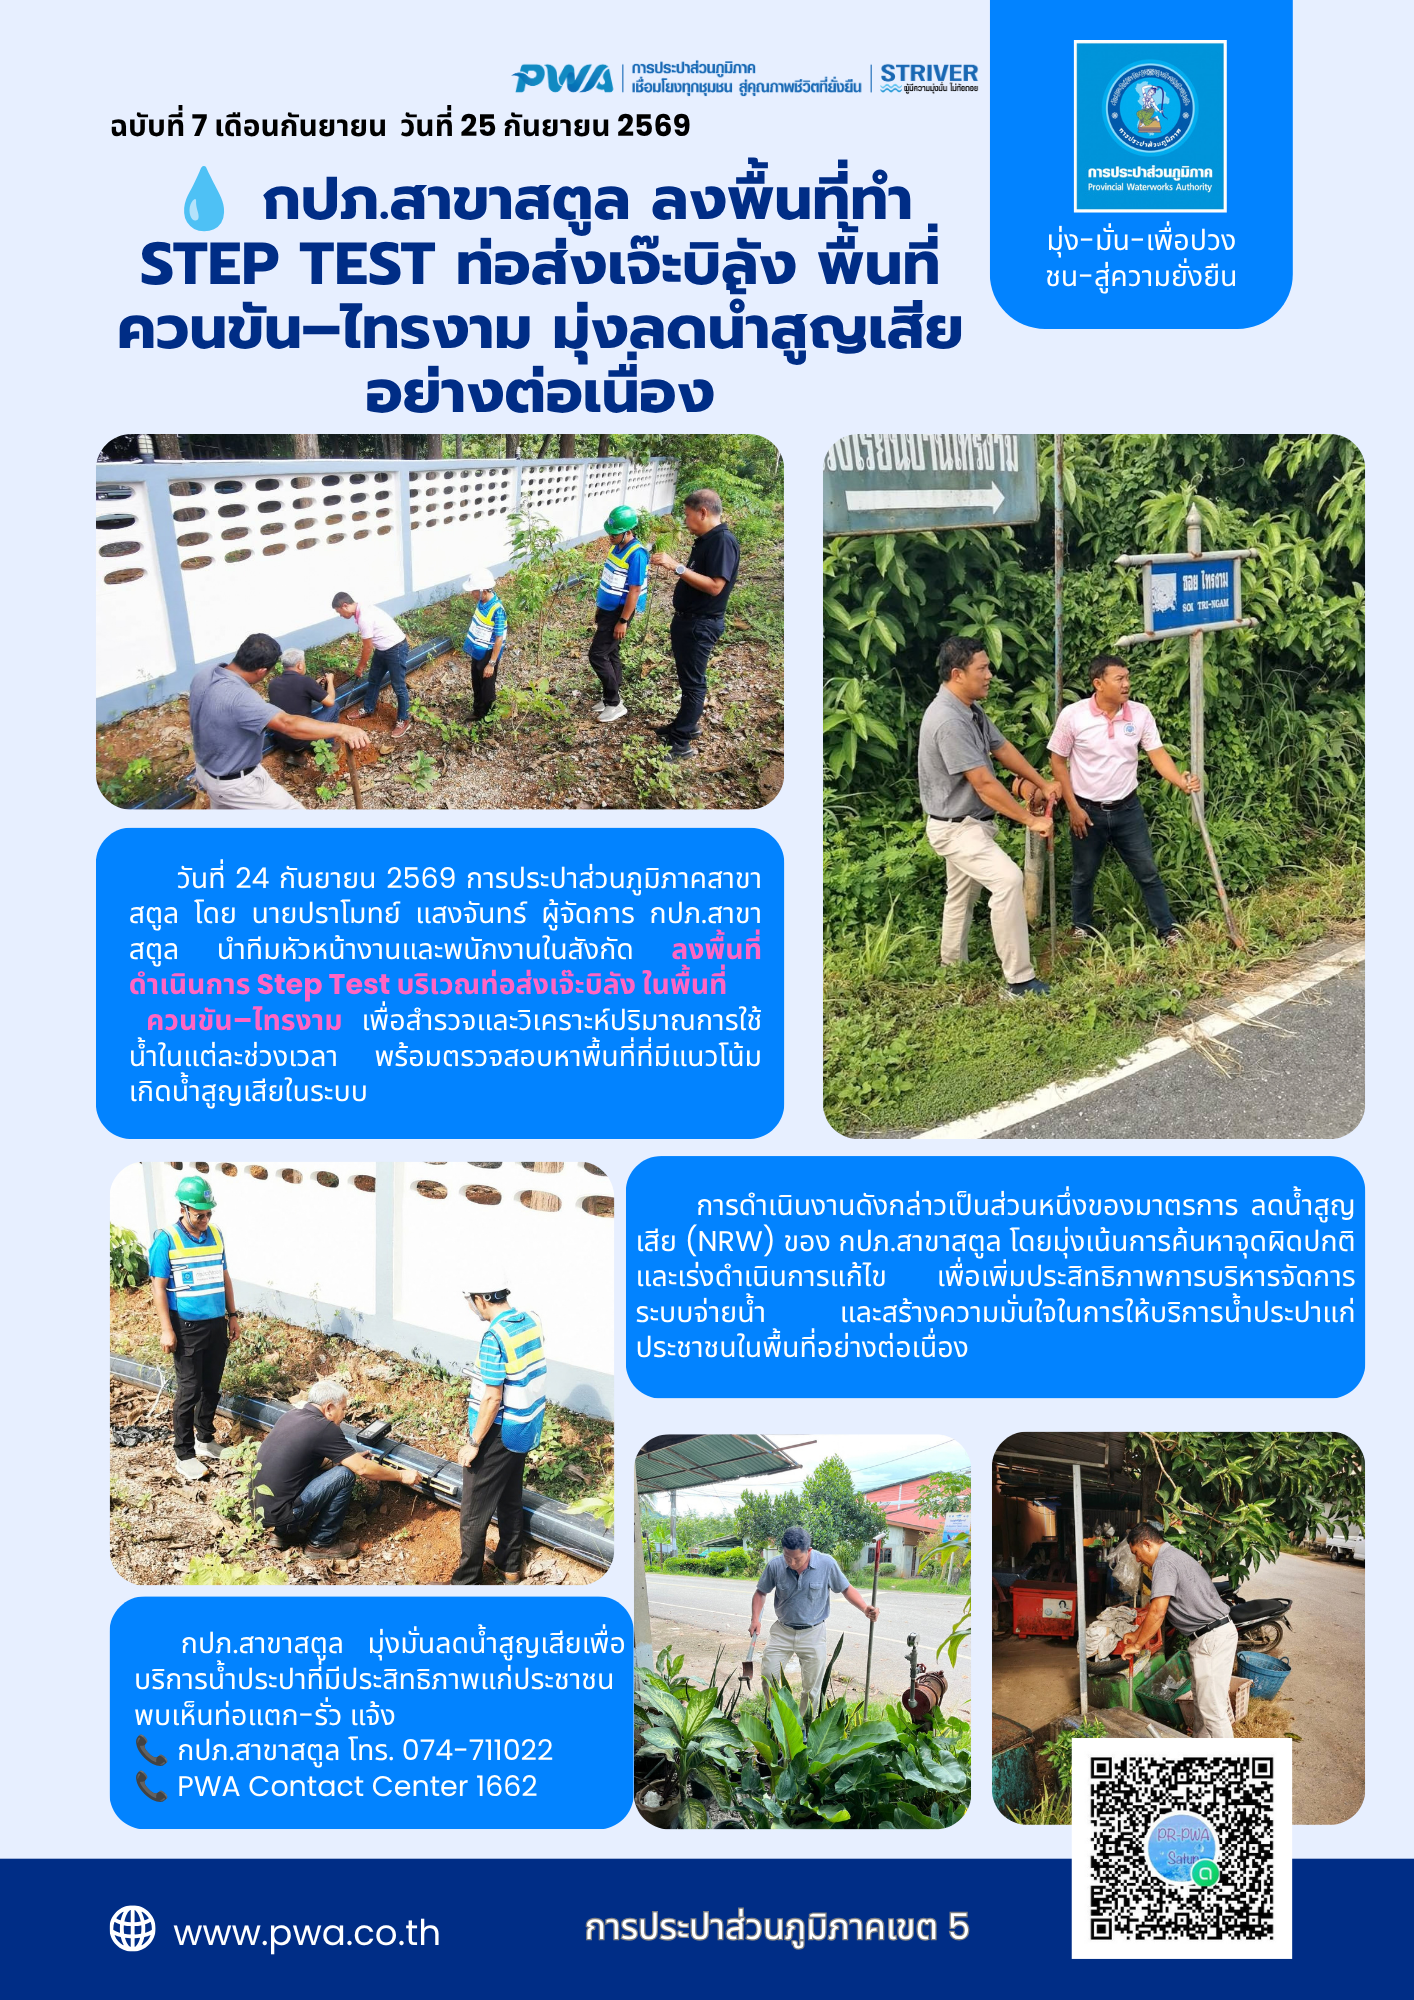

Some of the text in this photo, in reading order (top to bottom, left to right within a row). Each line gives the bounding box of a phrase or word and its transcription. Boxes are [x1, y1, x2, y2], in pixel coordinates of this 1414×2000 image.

[512, 64, 613, 93] PWA
[632, 60, 755, 77] การประปาส่วนภูมิภาค
[881, 64, 978, 82] STRIVER
[632, 77, 861, 96] เชื่อมโยงทุกชุมชน สู่คุณภาพชีวิตที่ยั่งยืน
[111, 105, 690, 137] ฉบับที่ 7 เดือนกันยายน วันที่ 25 กันยายน 2569
[1088, 165, 1213, 181] การประปาส่วนภูมิภาค
[1088, 183, 1212, 193] Provincial Waterworks Authority
[263, 157, 911, 236] กปภ.สาขาสตูล ลงพื้นที่ทำ
[141, 221, 938, 285] STEP TEST ท่อส่งเจ๊ะบิลัง พื้นที่
[1049, 221, 1235, 258] มุ่ง-มั่น-เพื่อปวง
[1047, 258, 1235, 294] ชน-สู่ความยั่งยืน
[119, 285, 961, 365] ควนขัน–ไทรงาม มุ่งลดน้ำสูญเสีย
[367, 350, 714, 413] อย่างต่อเนื่อง
[1182, 569, 1229, 592] ซอย ไทรงาม
[1182, 598, 1229, 613] SOI TRI-NGAM
[178, 859, 760, 896] วันที่ 24 กันยายน 2569 การประปาส่วนภูมิภาคสาขา
[130, 899, 760, 931] สตูล โดย นายปราโมทย์ แสงจันทร์ ผู้จัดการ กปภ.สาขา
[130, 942, 177, 967] สตูล
[672, 929, 760, 960] ลงพื้นที่
[130, 964, 726, 1002] ดำเนินการ Step Test บริเวณท่อส่งเจ๊ะบิลัง ในพื้นที่
[148, 1006, 341, 1031] ควนขัน–ไทรงาม
[131, 1037, 336, 1067] น้ำในแต่ละช่วงเวลา
[131, 1072, 366, 1109] เกิดน้ำสูญเสียในระบบ
[1252, 1186, 1354, 1223] ลดน้ำสูญ
[638, 1228, 675, 1252] เสีย
[687, 1224, 773, 1257] (NRW)
[785, 1235, 830, 1252] ของ
[840, 1229, 1001, 1259] กปภ.สาขาสตูล
[638, 1262, 885, 1287] และเร่งดำเนินการแก้ไข
[637, 1293, 764, 1323] ระบบจ่ายน้ำ
[182, 1624, 624, 1661] กปภ.สาขาสตูล มุ่งมั่นลดน้ำสูญเสียเพื่อ
[135, 1697, 395, 1726] พบเห็นท่อแตก-รั่ว แจ้ง
[179, 1736, 553, 1768] กปภ.สาขาสตูล โทร. 074-711022
[179, 1775, 537, 1797] PWA Contact Center 1662
[1157, 1827, 1210, 1841] PR-PWA
[174, 1918, 439, 1955] www.pwa.co.th
[586, 1907, 969, 1950] การประปาส่วนภูมิภาคเขต 5
